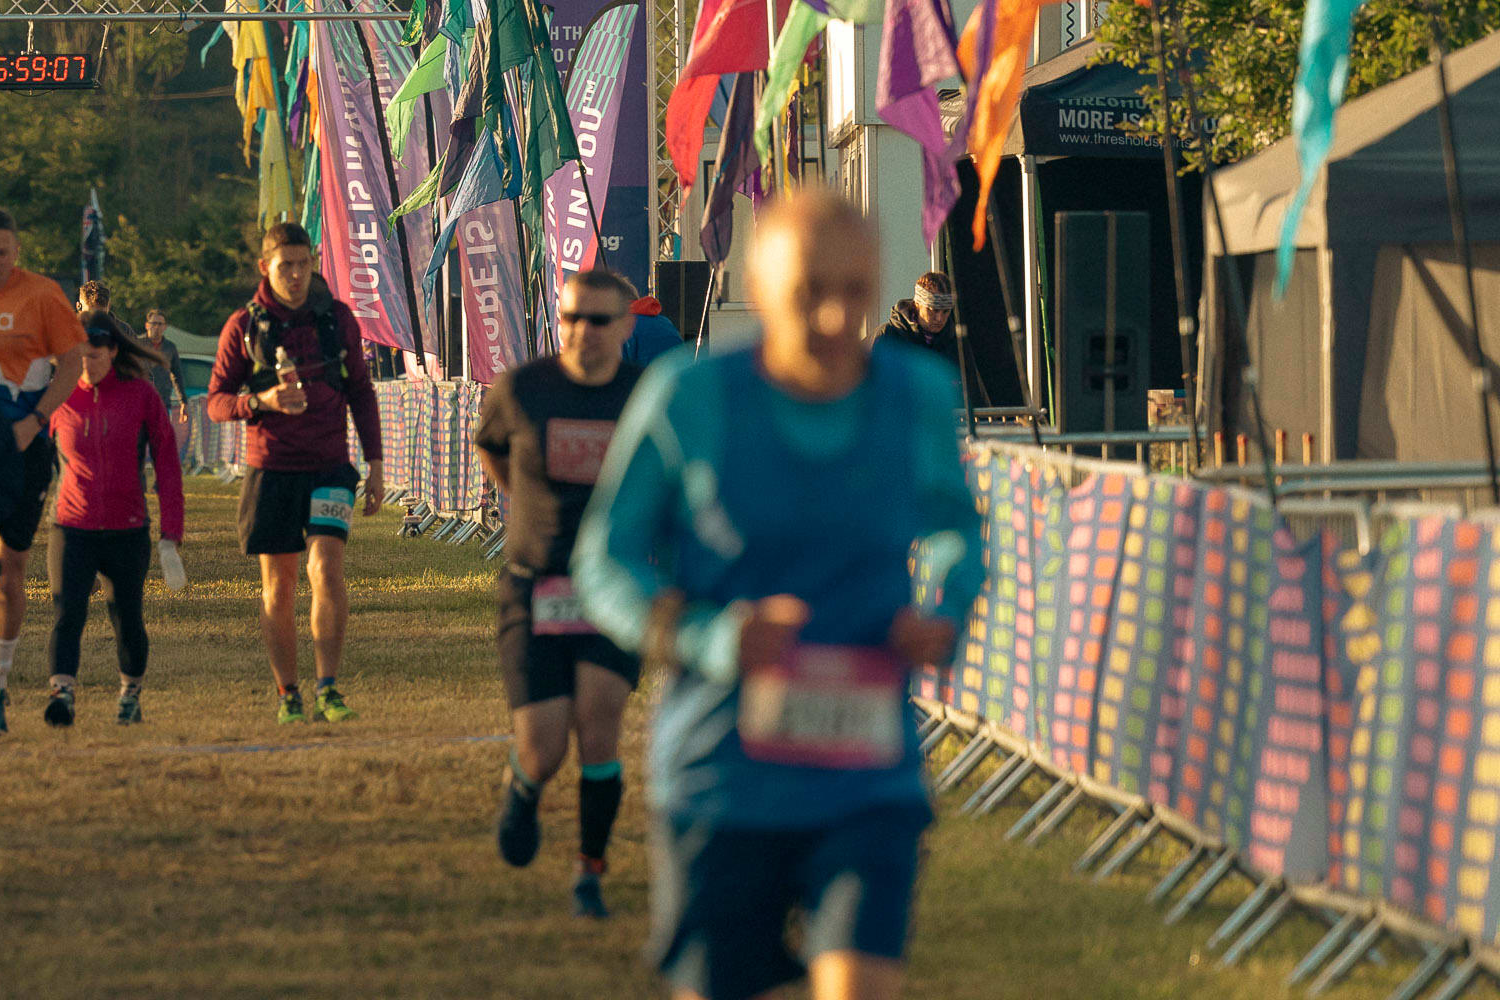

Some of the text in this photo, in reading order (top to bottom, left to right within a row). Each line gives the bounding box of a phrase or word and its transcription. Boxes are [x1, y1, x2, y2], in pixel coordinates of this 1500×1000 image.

[1059, 109, 1115, 130] MORE
[566, 189, 588, 229] IN
[561, 236, 582, 272] IS
